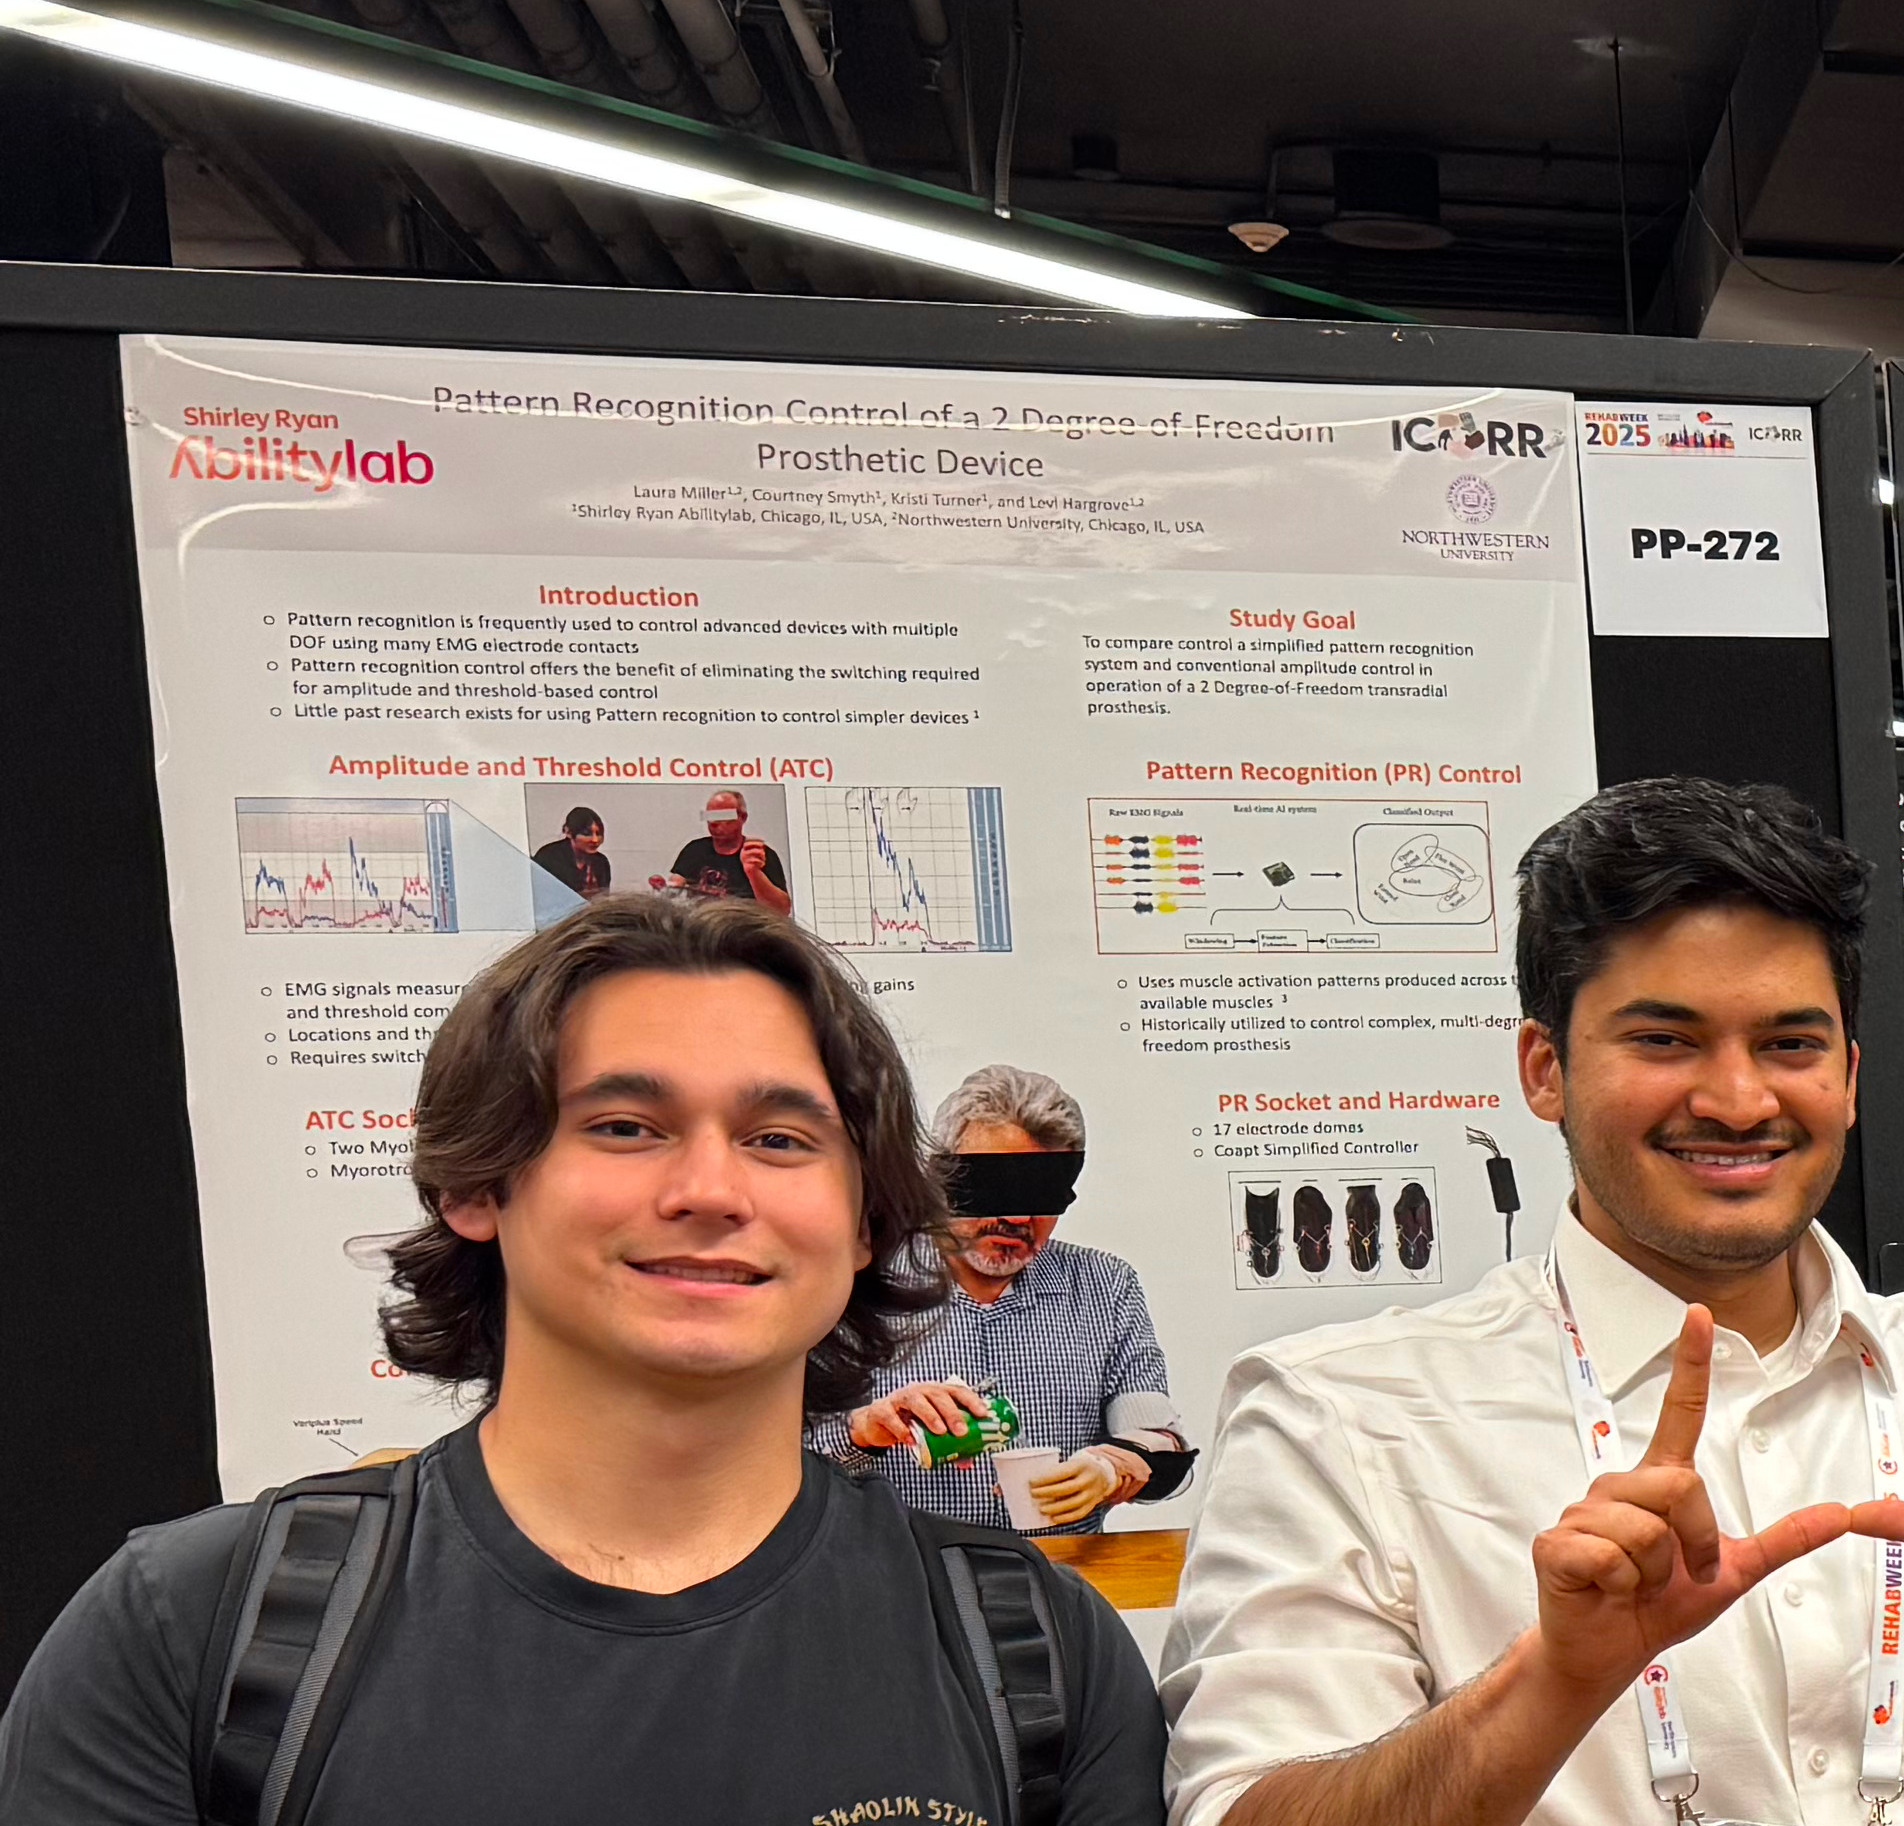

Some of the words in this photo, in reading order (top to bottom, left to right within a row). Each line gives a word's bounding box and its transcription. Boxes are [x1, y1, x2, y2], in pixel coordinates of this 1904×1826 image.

[183, 406, 271, 433] Shirley
[273, 408, 340, 433] Ryan
[433, 385, 569, 418] Pattern
[573, 391, 773, 427] Recognition
[787, 400, 908, 428] Control
[994, 407, 1010, 434] 2
[1021, 407, 1337, 444] Degree-of-Freedom
[1585, 423, 1652, 447] 2025
[757, 443, 925, 473] Prosthetic
[937, 449, 1043, 477] Device
[1402, 530, 1549, 550] NORTHWESTERN
[1631, 528, 1780, 560] PP-272
[1441, 549, 1514, 562] UNIVERSITY
[539, 585, 699, 607] Introduction
[287, 612, 351, 626] Pattern
[357, 614, 454, 630] recognition
[460, 614, 473, 628] is
[478, 614, 566, 633] frequently
[572, 616, 611, 630] used
[616, 618, 633, 631] to
[638, 617, 697, 632] control
[703, 618, 781, 633] advanced
[786, 620, 847, 634] devices
[851, 621, 887, 635] with
[892, 622, 958, 639] multiple
[1230, 608, 1296, 632] Study
[1303, 610, 1356, 631] Goal
[329, 754, 470, 779] Amplitude
[477, 756, 526, 777] and
[533, 756, 662, 779] Threshold
[668, 757, 762, 779] Control
[769, 757, 834, 783] (ATC)
[1147, 760, 1234, 781] Pattern
[1239, 762, 1378, 786] Recognition
[1384, 763, 1432, 786] (PR)
[1439, 763, 1522, 785] Control
[1218, 1094, 1248, 1112] PR
[1255, 1093, 1331, 1111] Socket
[1339, 1091, 1382, 1111] and
[1388, 1090, 1500, 1110] Hardware
[1882, 1541, 1903, 1655] REHABWEE
